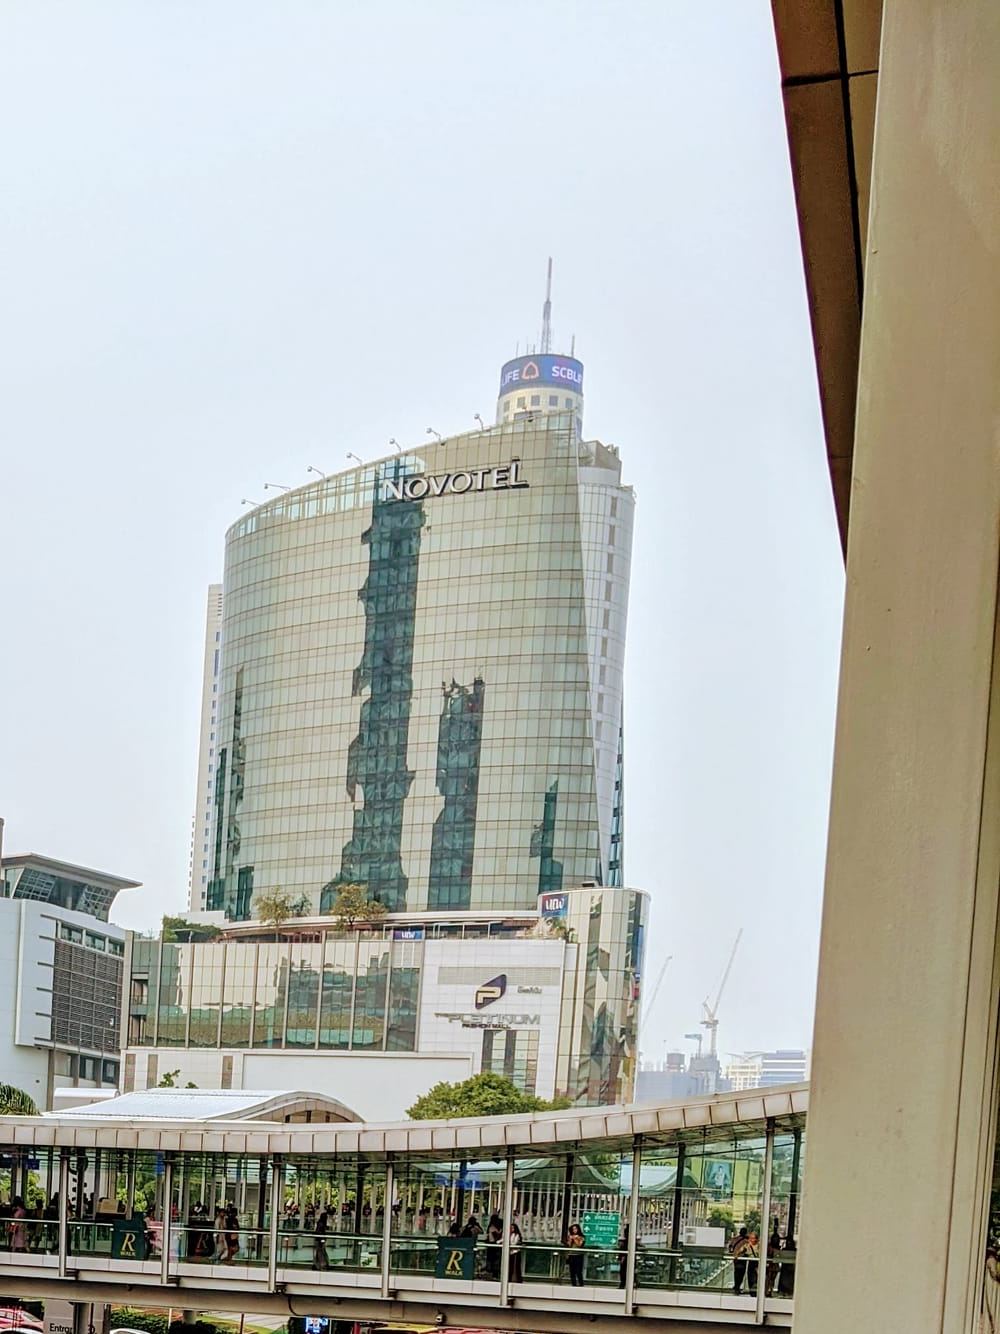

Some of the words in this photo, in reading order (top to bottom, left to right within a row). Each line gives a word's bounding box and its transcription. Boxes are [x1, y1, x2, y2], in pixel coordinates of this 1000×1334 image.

[383, 457, 529, 503] NOVOTEL
[121, 1232, 136, 1252] R
[446, 1250, 463, 1270] R
